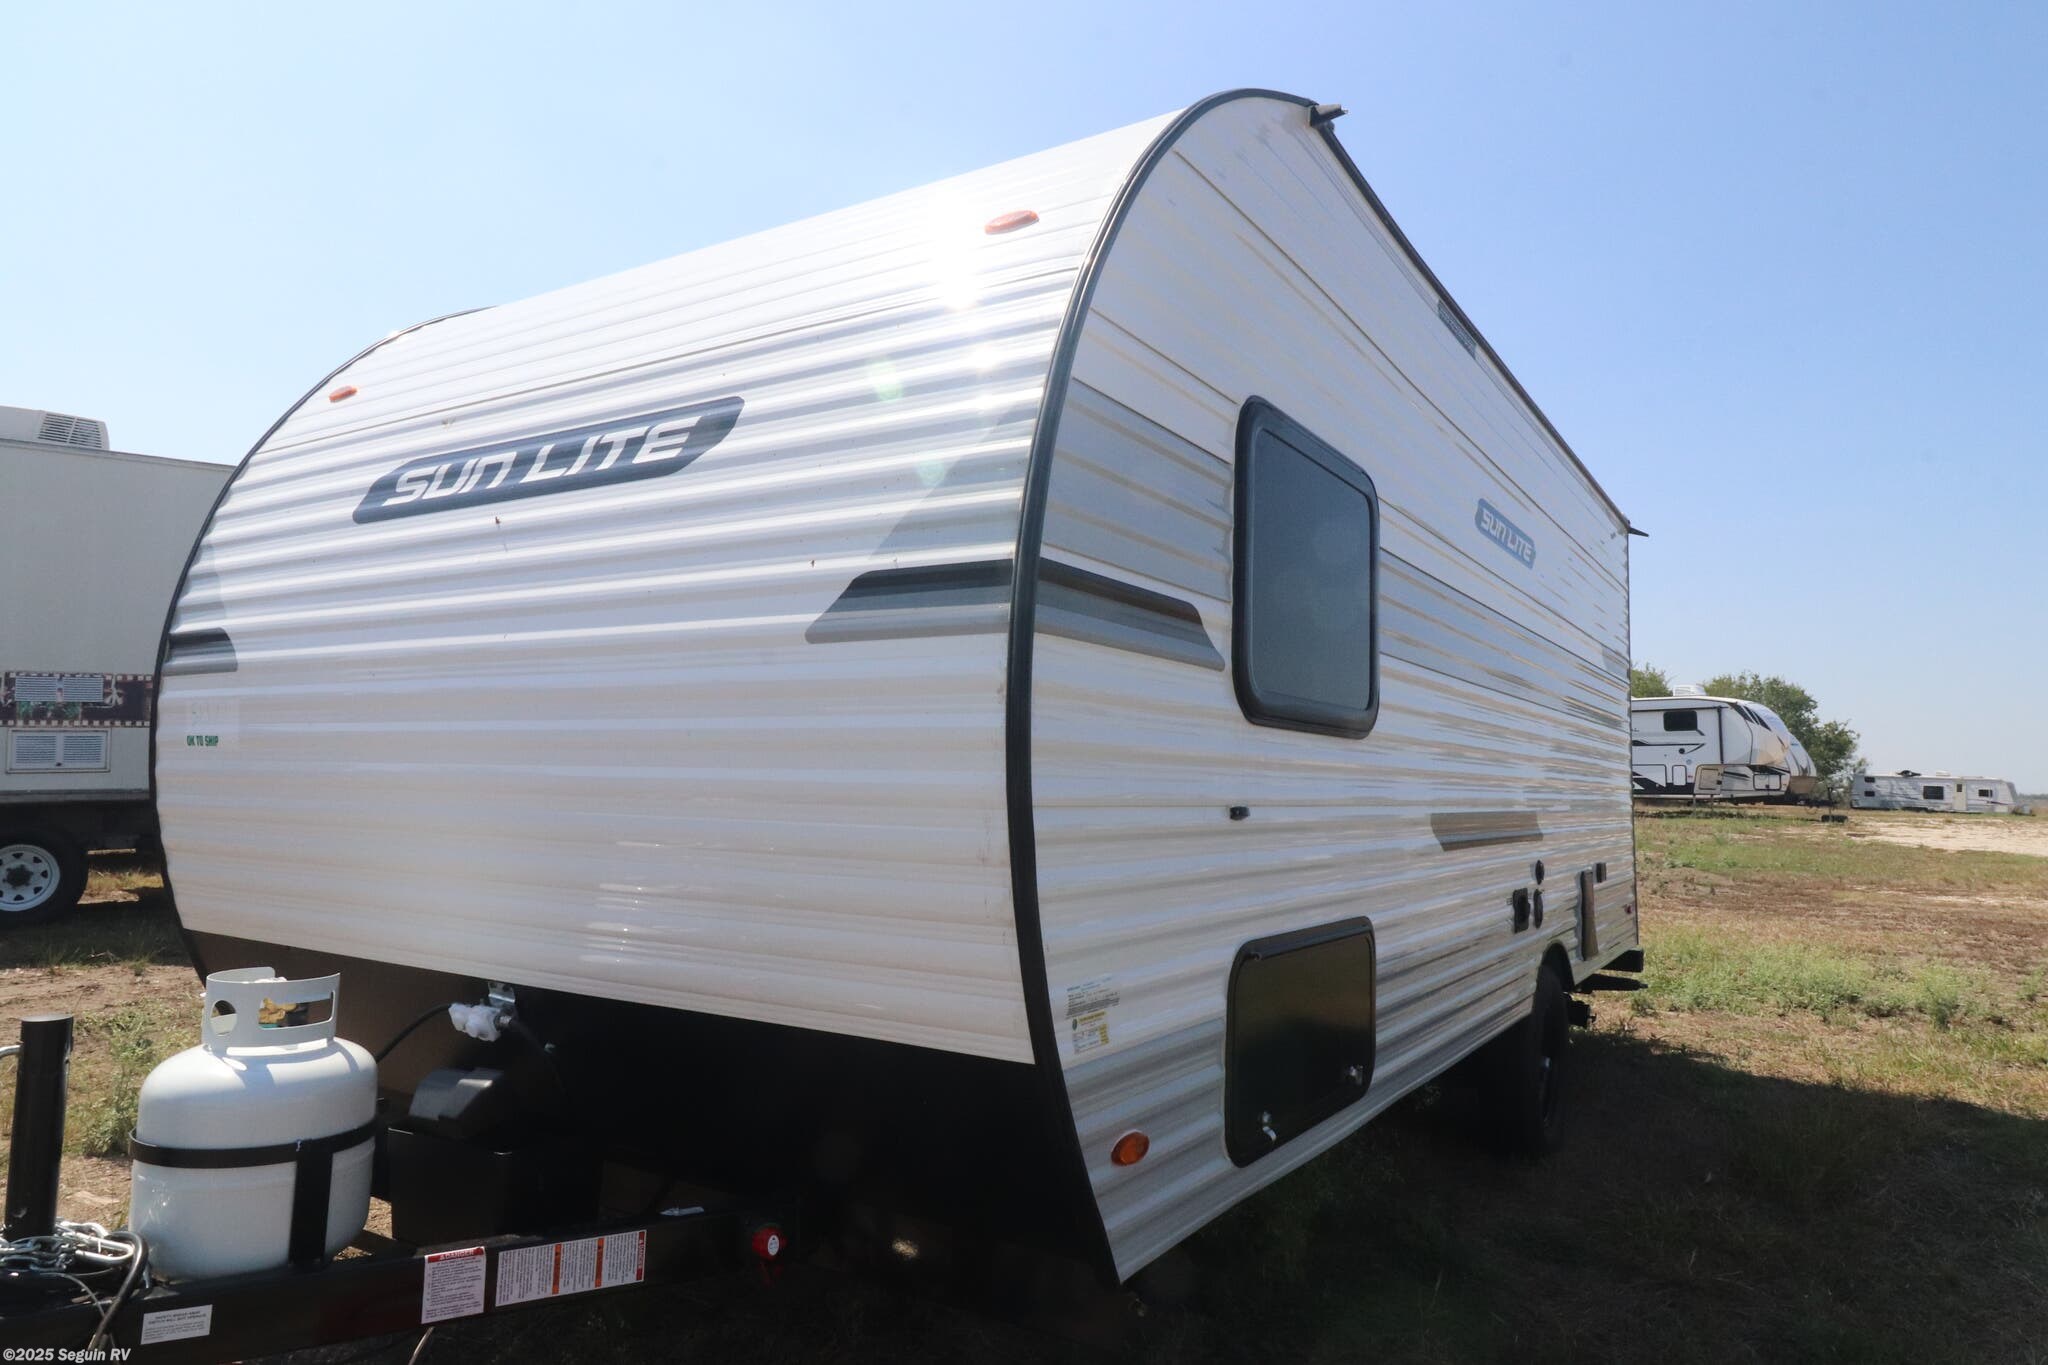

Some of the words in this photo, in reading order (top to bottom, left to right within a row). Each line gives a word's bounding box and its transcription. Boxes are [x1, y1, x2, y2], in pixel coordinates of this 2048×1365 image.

[383, 451, 517, 506] SUN
[521, 416, 702, 483] LITE
[1480, 507, 1506, 543] SUN
[1507, 527, 1534, 562] LITE
[187, 735, 195, 747] OK
[196, 735, 203, 747] TO
[205, 735, 219, 747] SHIP
[445, 1249, 474, 1260] DANGER
